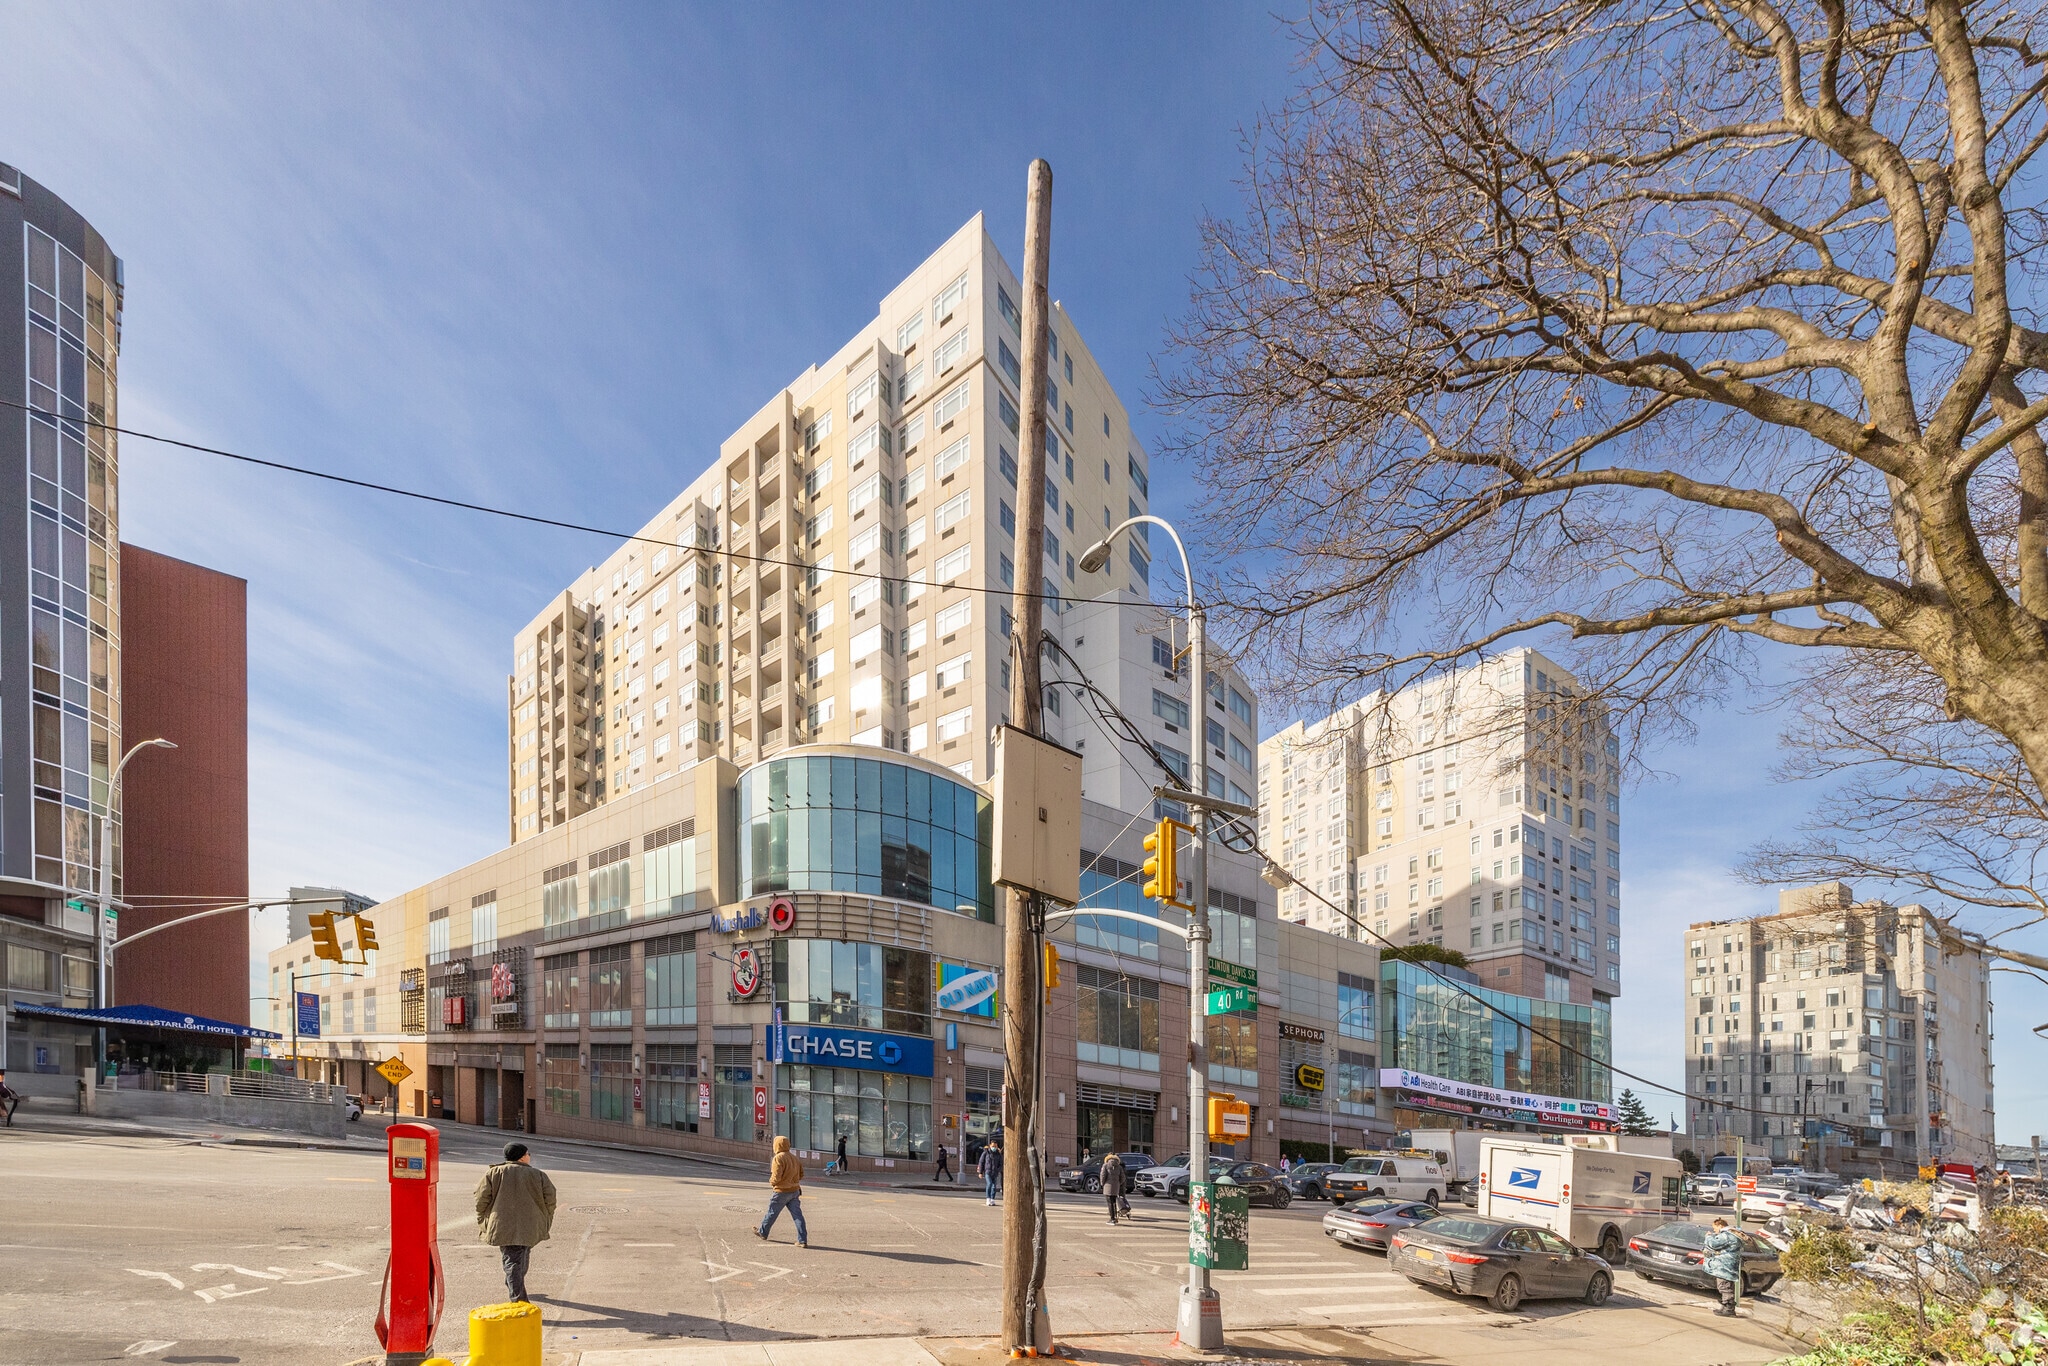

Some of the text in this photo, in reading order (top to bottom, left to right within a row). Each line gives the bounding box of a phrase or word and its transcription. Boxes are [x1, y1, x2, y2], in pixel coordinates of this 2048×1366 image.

[708, 907, 762, 935] Marshalls
[1208, 959, 1231, 974] CLINTON
[1226, 974, 1239, 982] ROAD
[940, 974, 996, 1009] OLD NAVY
[1218, 990, 1243, 1010] 40 Rd
[153, 1020, 237, 1035] STARLIGHT HOTEL
[1284, 1025, 1324, 1040] SEPHORA
[788, 1035, 874, 1060] CHASE
[1303, 1069, 1325, 1080] BEST
[1304, 1077, 1322, 1087] BUY
[1410, 1075, 1451, 1094] ABI Health Care
[1582, 1105, 1597, 1114] Apply
[1542, 1112, 1583, 1126] Burlington
